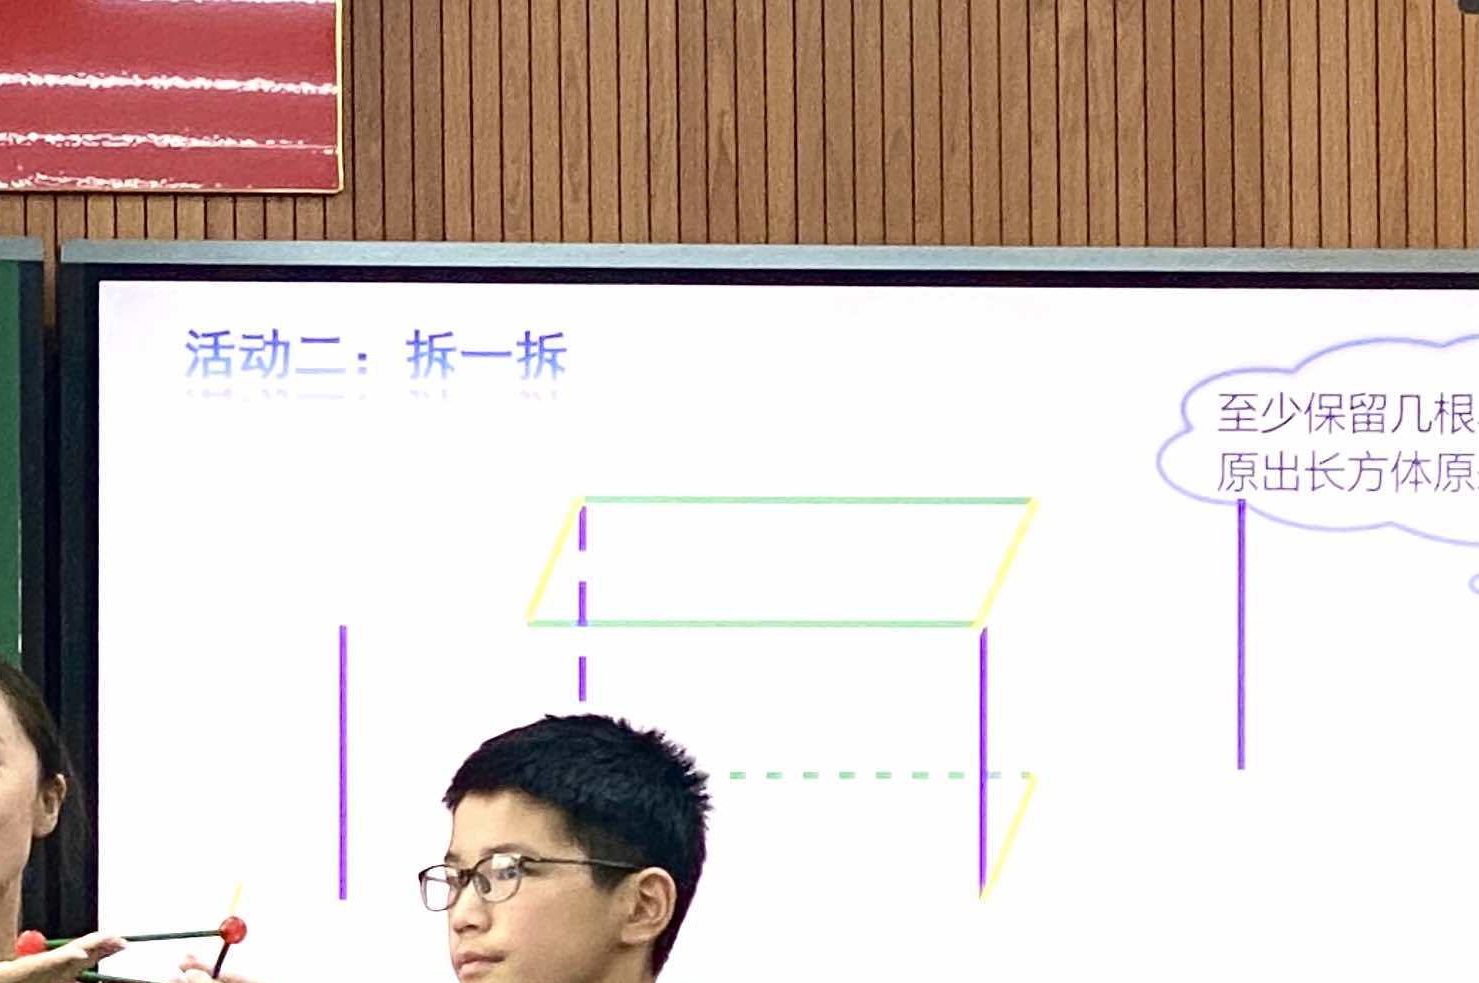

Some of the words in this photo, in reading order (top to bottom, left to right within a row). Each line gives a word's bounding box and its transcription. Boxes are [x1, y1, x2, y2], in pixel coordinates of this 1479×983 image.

[184, 328, 568, 380] 活动二：拆一拆
